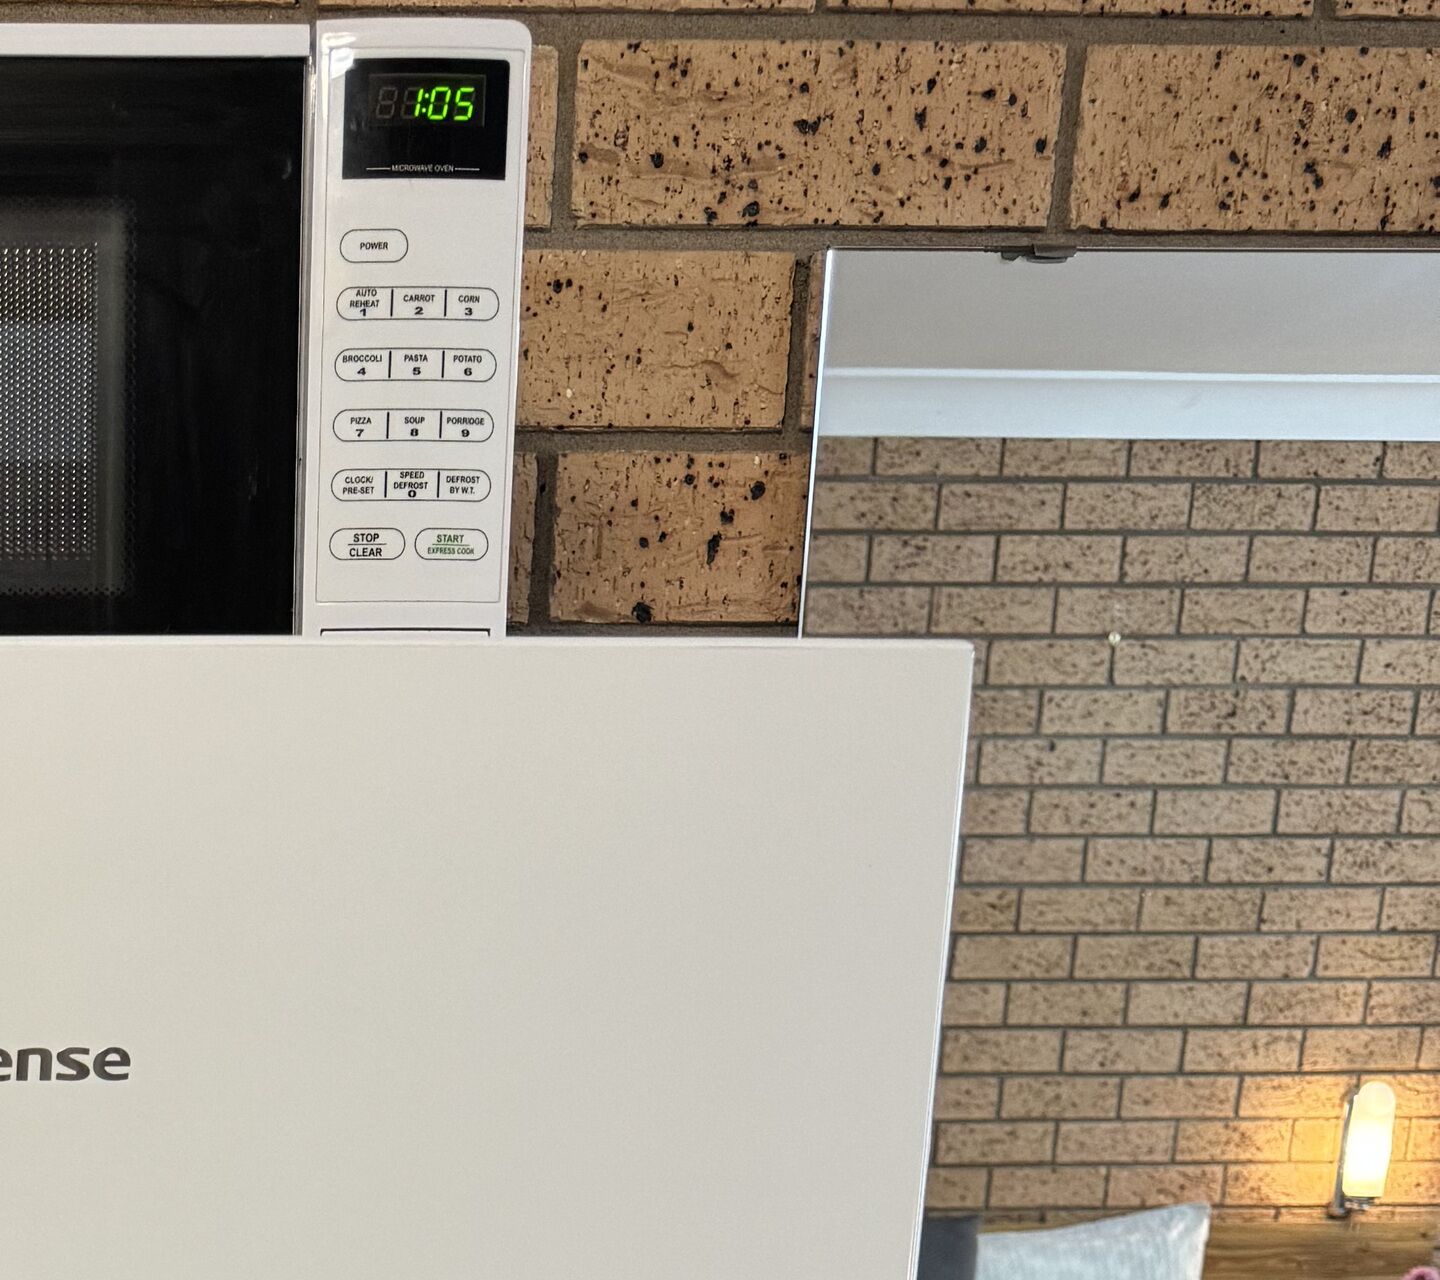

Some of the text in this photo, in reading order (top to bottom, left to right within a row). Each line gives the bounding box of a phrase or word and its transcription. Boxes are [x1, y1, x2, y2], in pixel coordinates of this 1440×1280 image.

[414, 86, 475, 121] 1:05
[391, 163, 454, 173] MICROWAVE OVEN
[359, 241, 389, 251] POWER
[355, 287, 378, 298] AUTO
[402, 293, 436, 303] CARROT
[457, 294, 480, 304] CORN
[349, 299, 380, 309] REHEAT
[359, 307, 367, 317] 1
[414, 306, 424, 316] 2
[464, 307, 473, 317] 3
[342, 354, 383, 364] BROCCOLI
[403, 353, 429, 363] PASTA
[452, 354, 483, 364] POTATO
[356, 367, 367, 376] 4
[412, 366, 422, 376] 5
[463, 367, 473, 377] 6
[350, 416, 372, 425] PIZZA
[404, 415, 426, 425] SOUP
[446, 416, 485, 426] PORRIDGE
[355, 428, 365, 438] 7
[410, 427, 419, 437] 8
[460, 428, 471, 438] 9
[399, 470, 425, 480] SPEED
[445, 475, 481, 484] DEFROST
[342, 486, 375, 495] PRE-SET
[393, 481, 429, 490] DEFROST
[449, 485, 460, 494] BY
[353, 532, 380, 543] STOP
[436, 533, 465, 544] START
[348, 547, 383, 558] CLEAR
[427, 546, 475, 555] EXPRESS COOK
